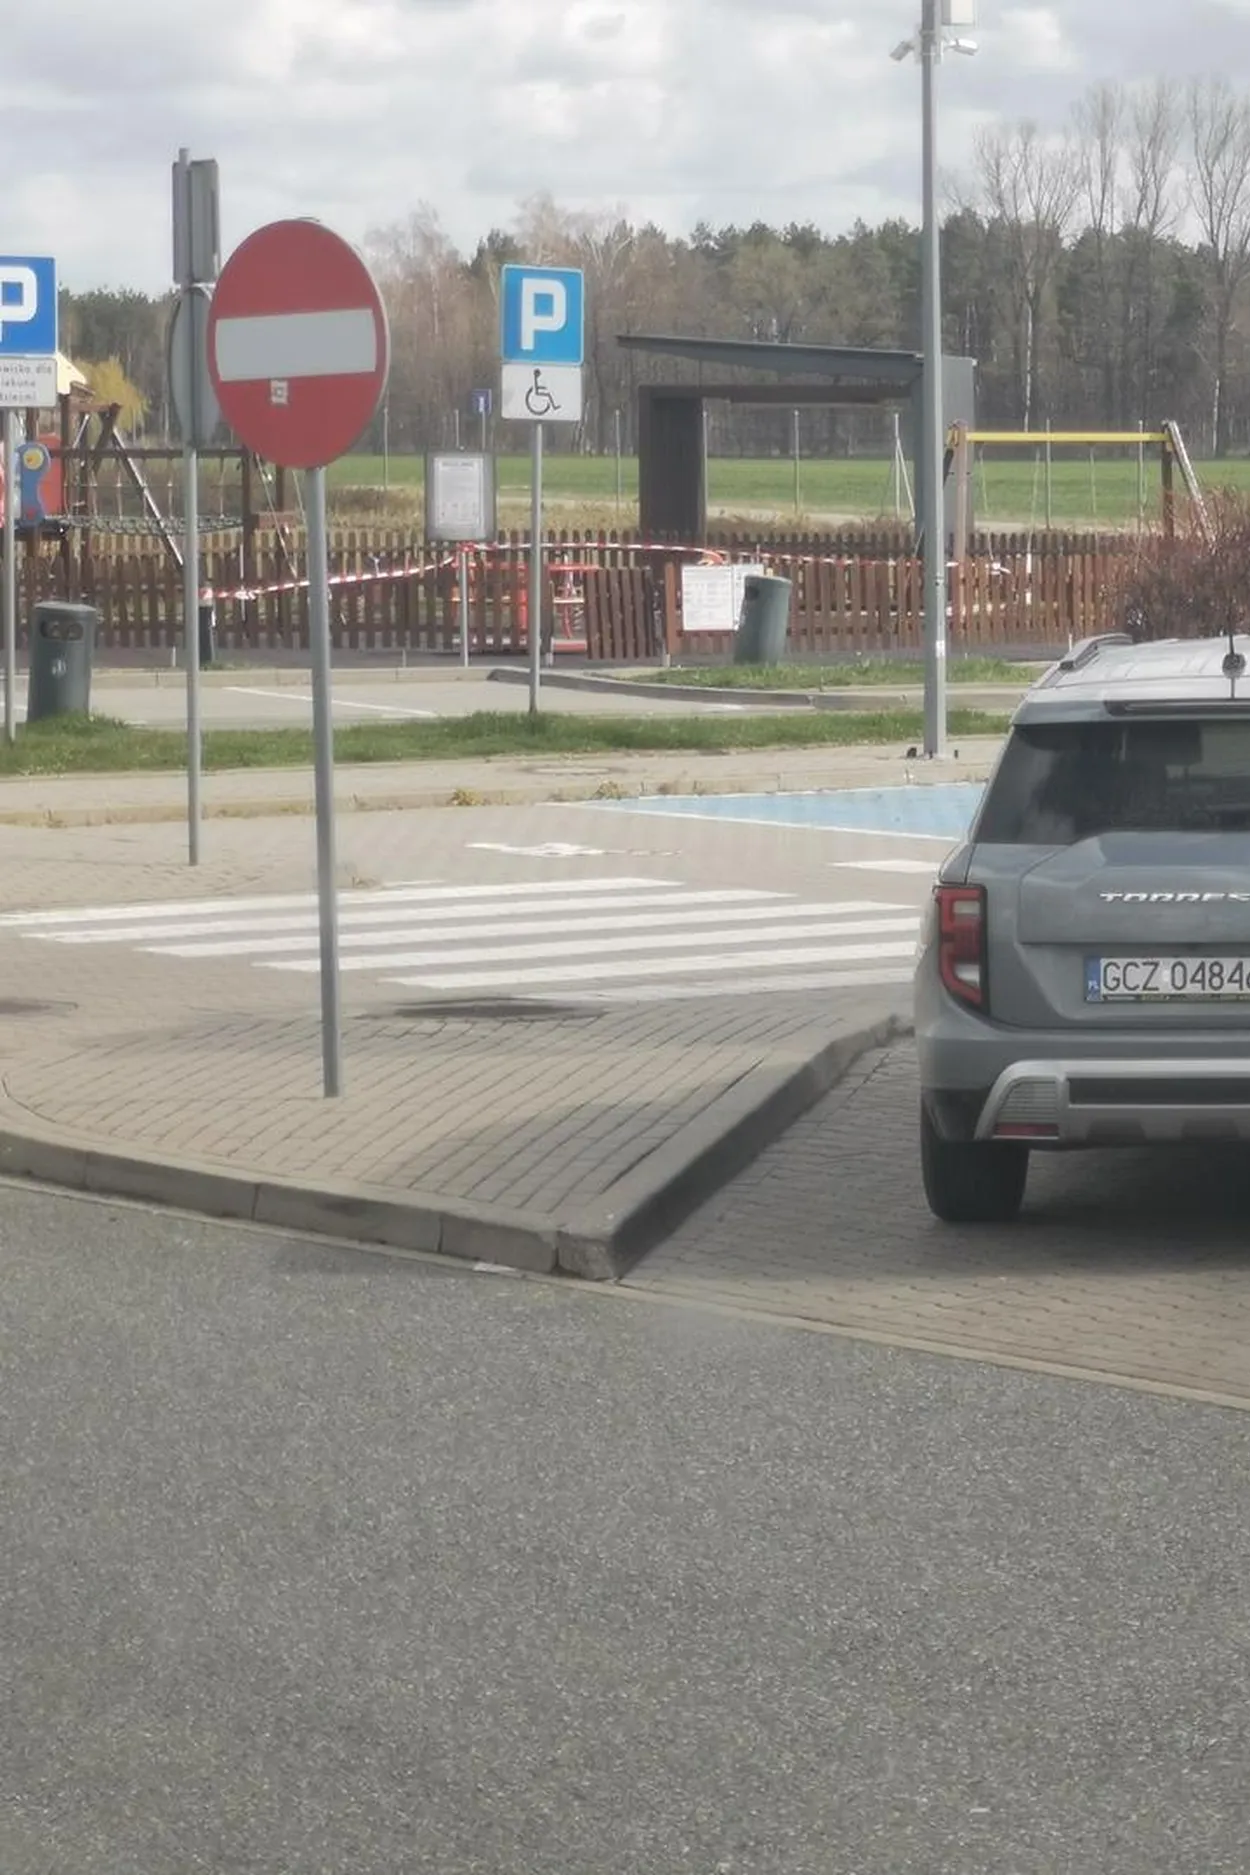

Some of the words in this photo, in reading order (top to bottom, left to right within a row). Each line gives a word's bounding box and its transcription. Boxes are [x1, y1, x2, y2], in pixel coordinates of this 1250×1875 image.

[0, 265, 38, 345] P
[520, 277, 567, 351] P
[1103, 960, 1160, 992] GCZ
